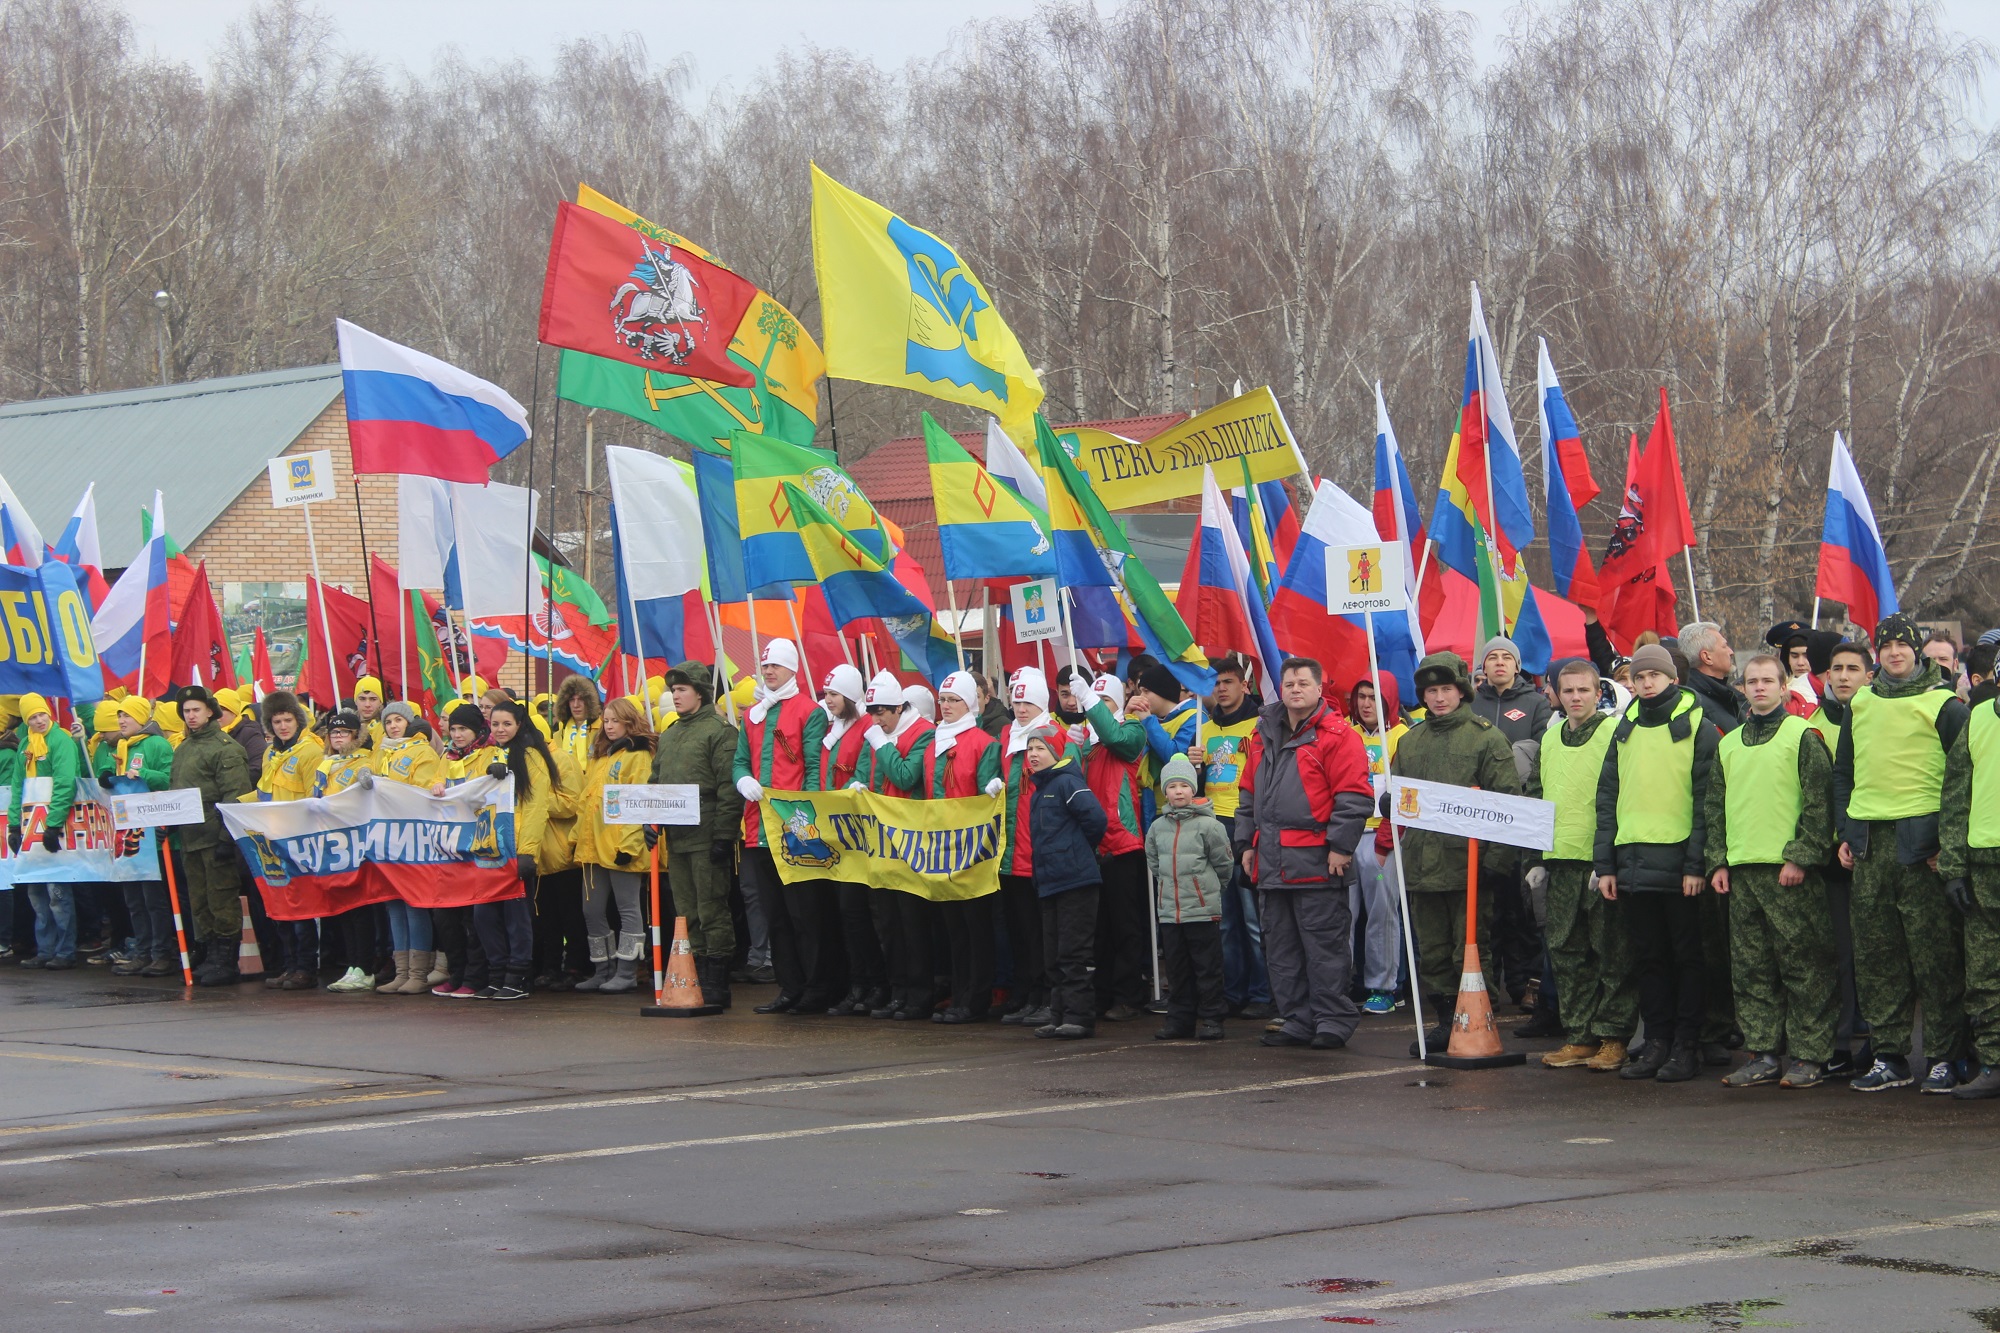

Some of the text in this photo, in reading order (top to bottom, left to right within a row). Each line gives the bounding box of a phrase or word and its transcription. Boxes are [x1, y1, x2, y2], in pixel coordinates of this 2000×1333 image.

[285, 492, 323, 503] КУЗЬМИНКИ
[1342, 599, 1391, 609] ЛЕФОРТОВО
[1020, 626, 1056, 638] ТЕКСТИЛЬЩИКИ
[137, 802, 181, 815] КУЗЬМИНКИ
[625, 799, 686, 810] ТЕКСТИЛЬЩИКИ
[1437, 802, 1514, 825] ЛЕФОРТОВО
